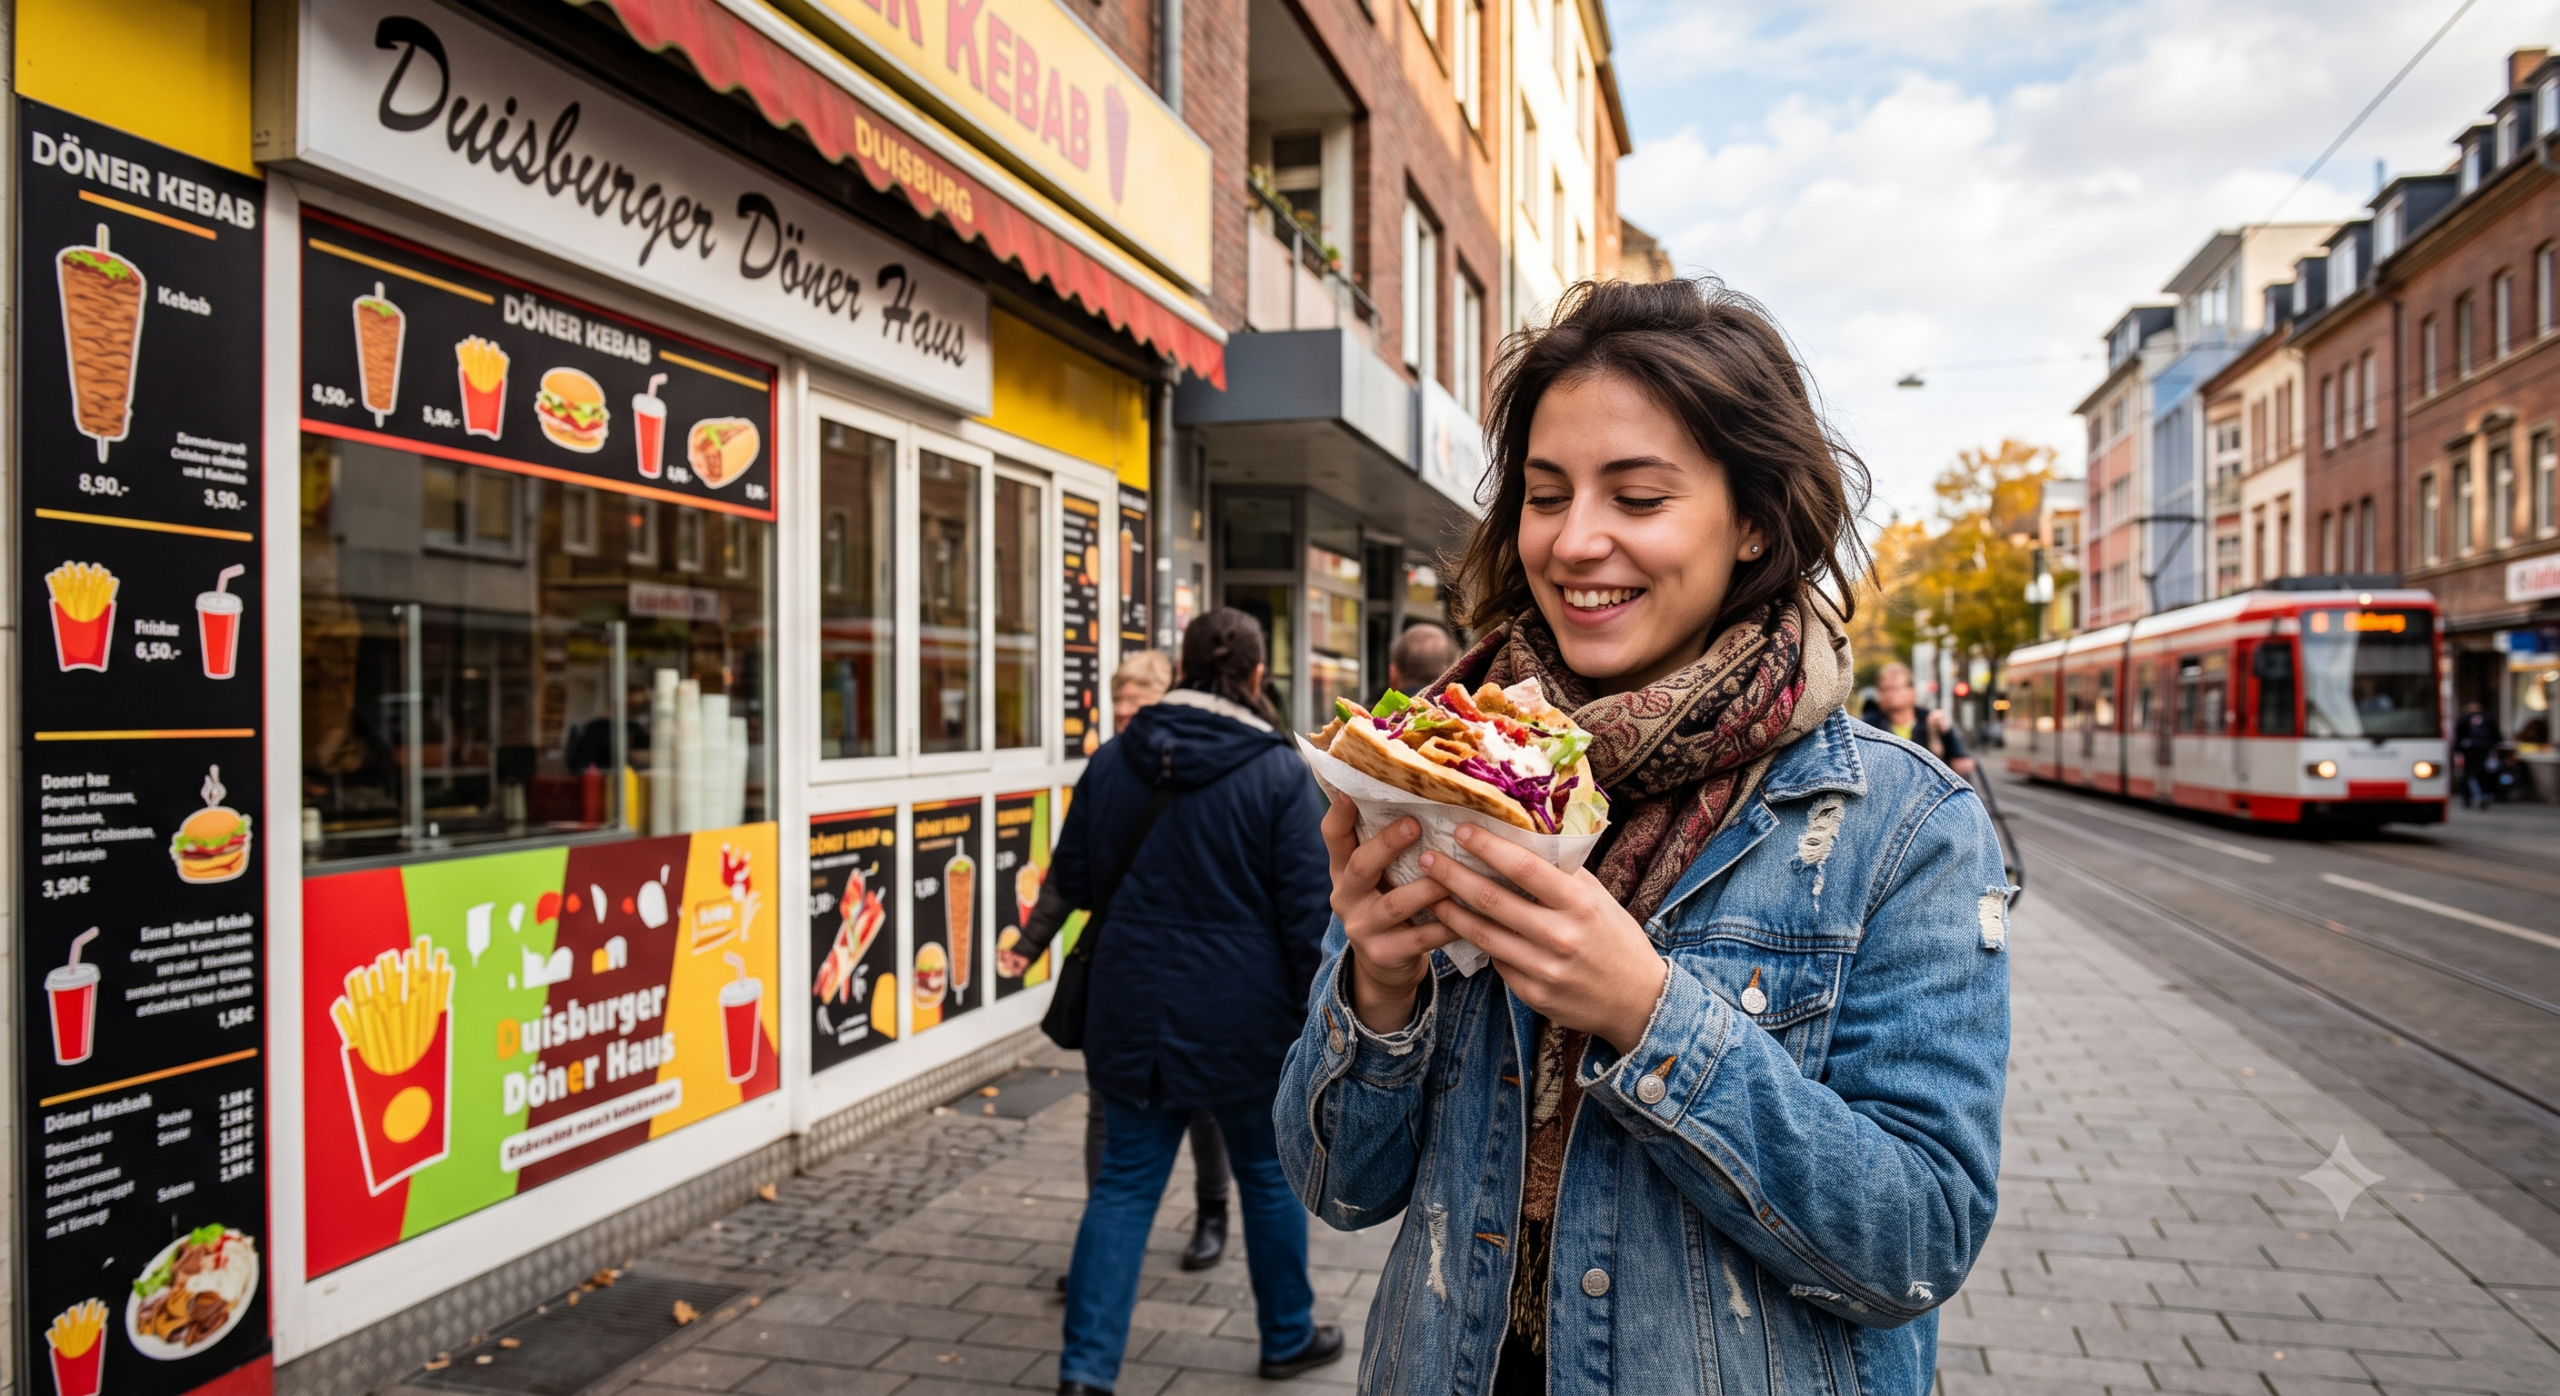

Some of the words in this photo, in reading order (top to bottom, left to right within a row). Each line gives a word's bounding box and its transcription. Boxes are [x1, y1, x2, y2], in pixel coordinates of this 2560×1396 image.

[946, 0, 1091, 172] KEBAB
[32, 131, 151, 198] DÖNER
[157, 171, 256, 230] KEBAB
[375, 17, 718, 266] Duisburger
[737, 192, 862, 324] Döner
[876, 263, 968, 369] Haus
[855, 114, 974, 224] DUISBURG
[158, 286, 211, 316] Kebab
[504, 294, 582, 344] DÖNER
[585, 319, 652, 364] KEBAB
[497, 984, 667, 1061] Duisburger
[503, 1060, 600, 1116] Döner
[606, 1031, 676, 1082] Haus
